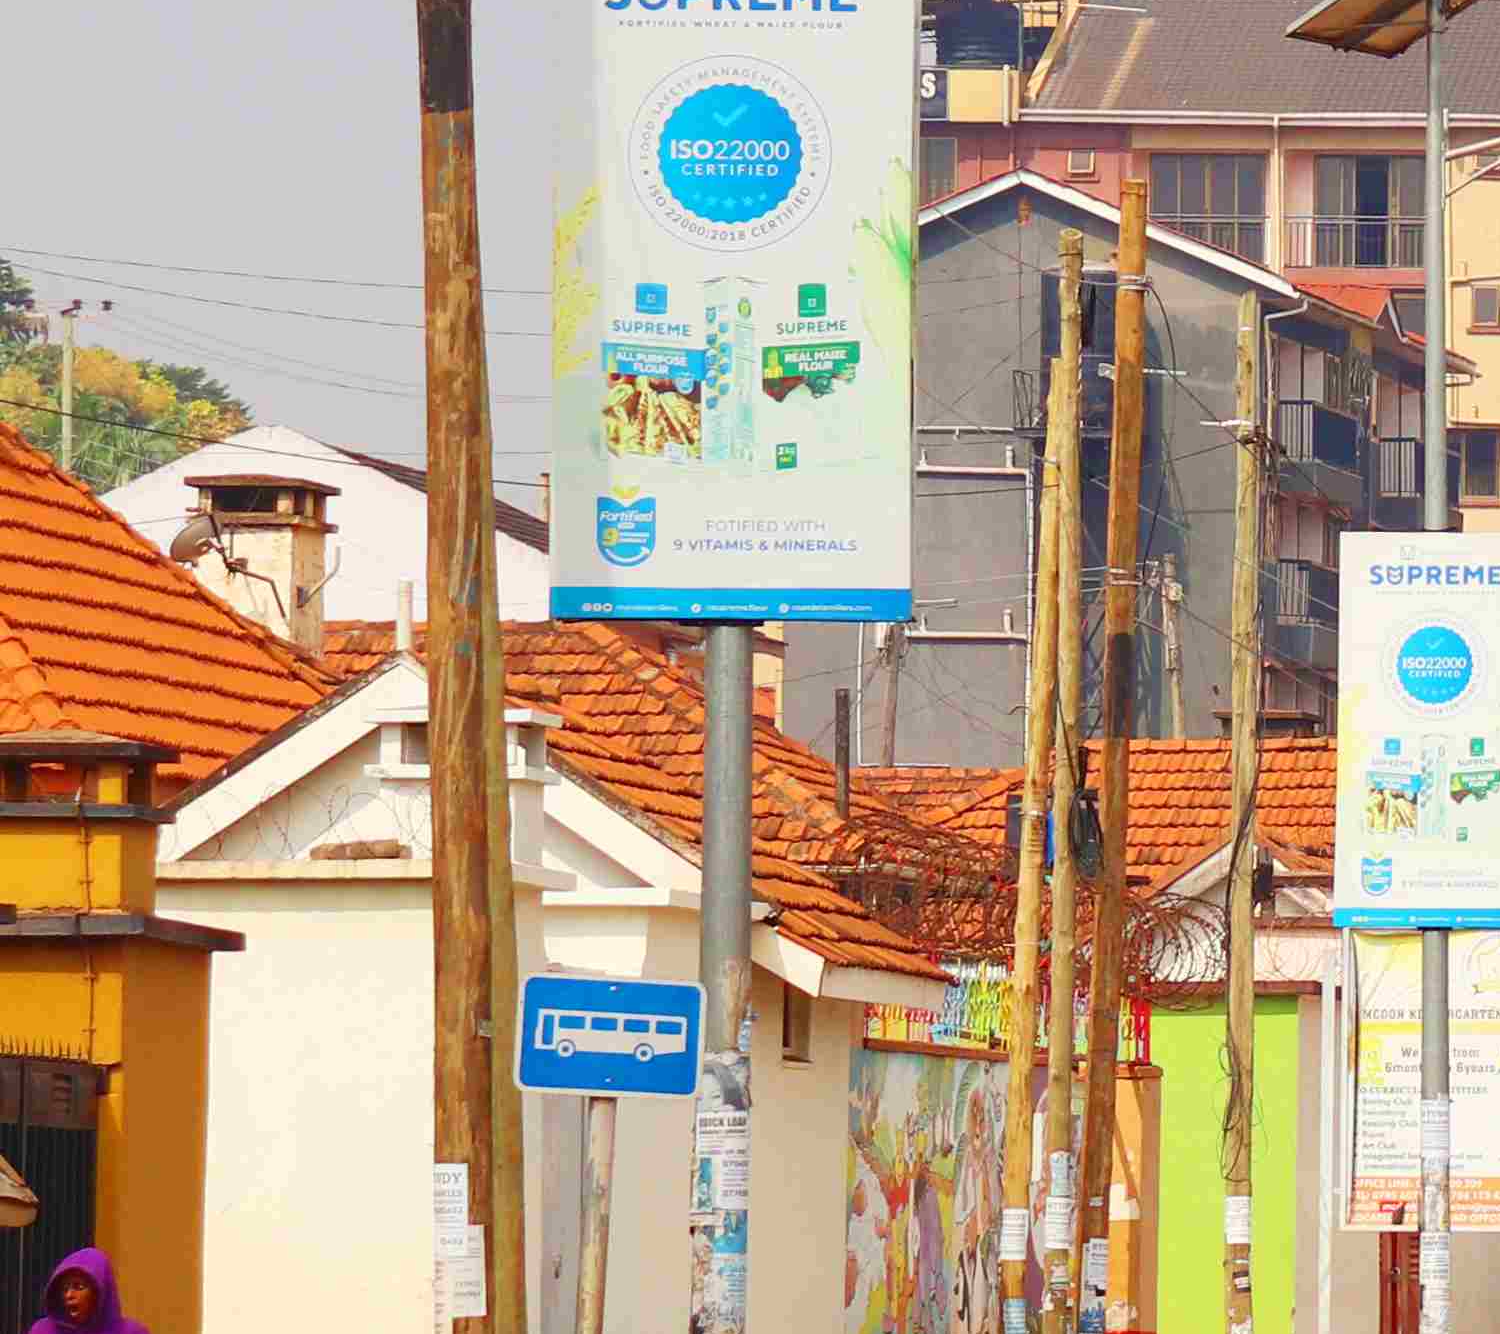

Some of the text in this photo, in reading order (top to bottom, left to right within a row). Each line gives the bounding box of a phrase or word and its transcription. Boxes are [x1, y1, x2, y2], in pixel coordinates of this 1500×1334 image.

[670, 139, 790, 161] ISO22000
[681, 163, 779, 178] CERTIFIED
[612, 319, 692, 337] SUPREME
[776, 319, 848, 337] SUPREME
[705, 519, 826, 533] FOTIFIED WITH
[672, 539, 858, 553] 9 VITAMIS & MINERALS
[1402, 656, 1468, 670] ISO22000
